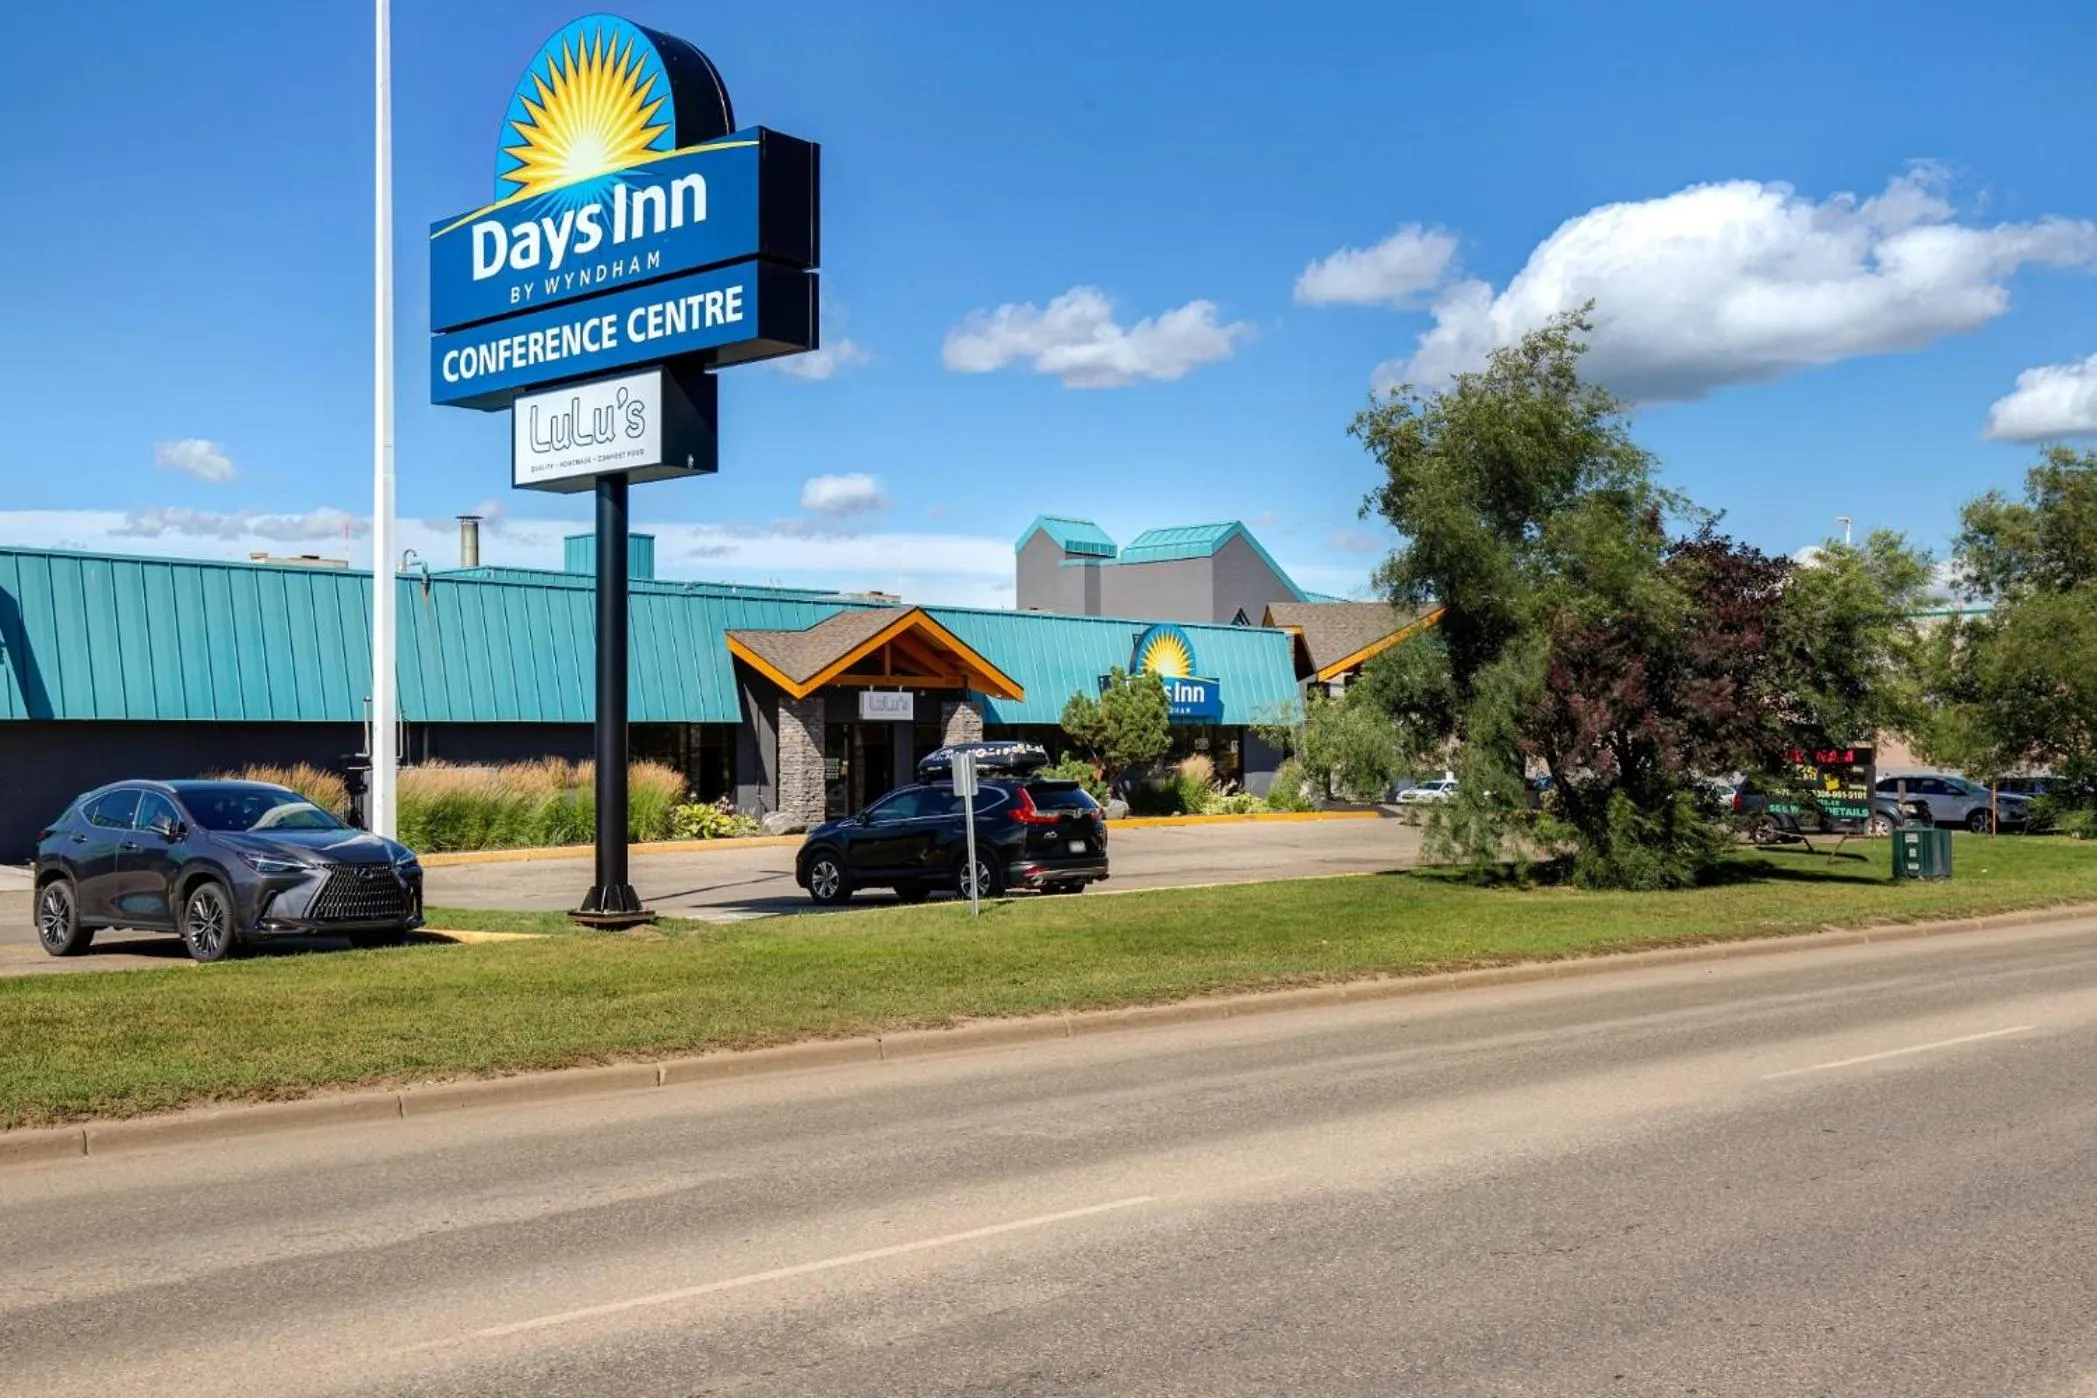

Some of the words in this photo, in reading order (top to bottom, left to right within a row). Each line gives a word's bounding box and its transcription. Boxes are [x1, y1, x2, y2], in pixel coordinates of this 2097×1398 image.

[472, 203, 603, 281] Days
[613, 172, 707, 244] Inn
[510, 281, 534, 304] BY
[545, 250, 660, 295] WYNDHAM
[443, 314, 617, 382] CONFERENCE
[627, 285, 744, 343] CENTRE
[1174, 681, 1205, 702] Inn
